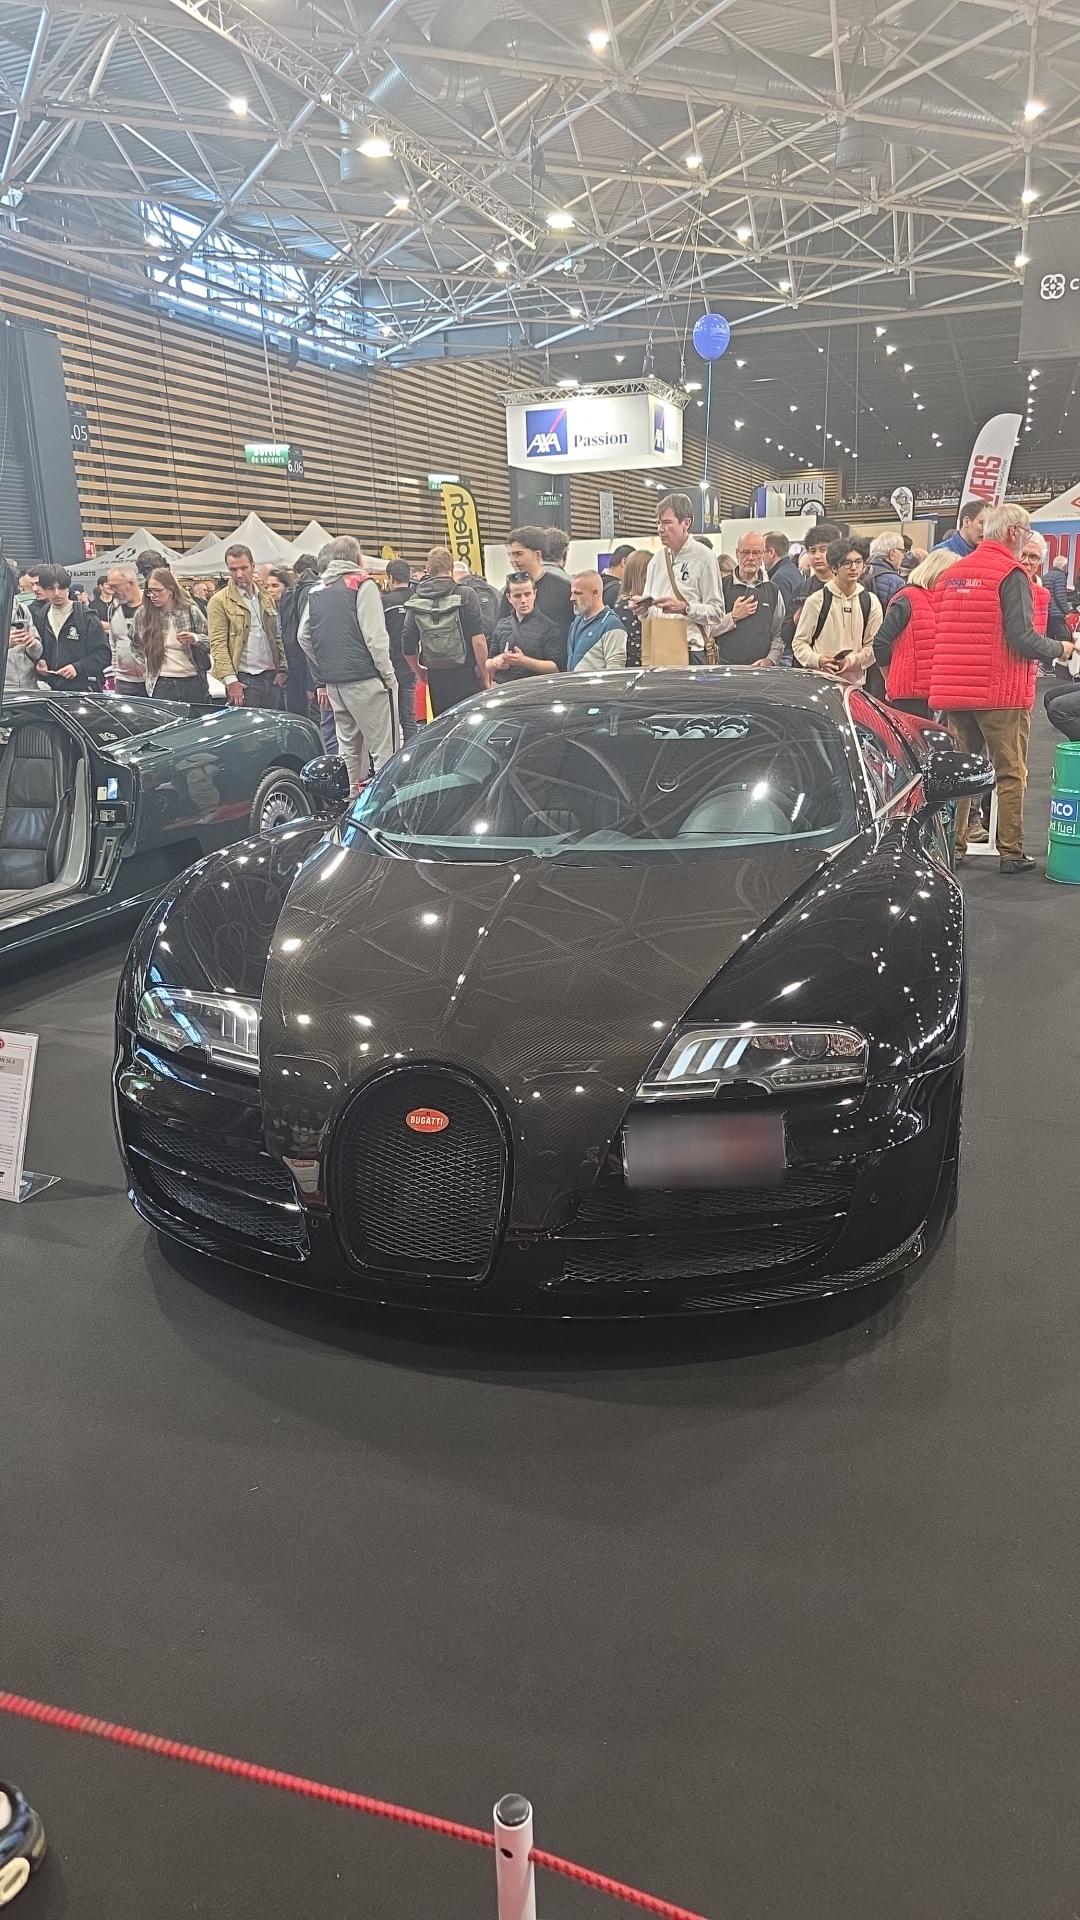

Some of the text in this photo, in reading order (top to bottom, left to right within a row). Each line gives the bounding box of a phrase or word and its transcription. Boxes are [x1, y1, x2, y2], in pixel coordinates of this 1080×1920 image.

[70, 424, 88, 442] .05
[526, 431, 628, 453] AXA Passion
[287, 460, 304, 474] 6.06
[772, 481, 824, 496] NCHÈRES
[784, 497, 808, 508] UTOS
[1057, 821, 1076, 835] fuel
[410, 1115, 444, 1127] BUGATTI
